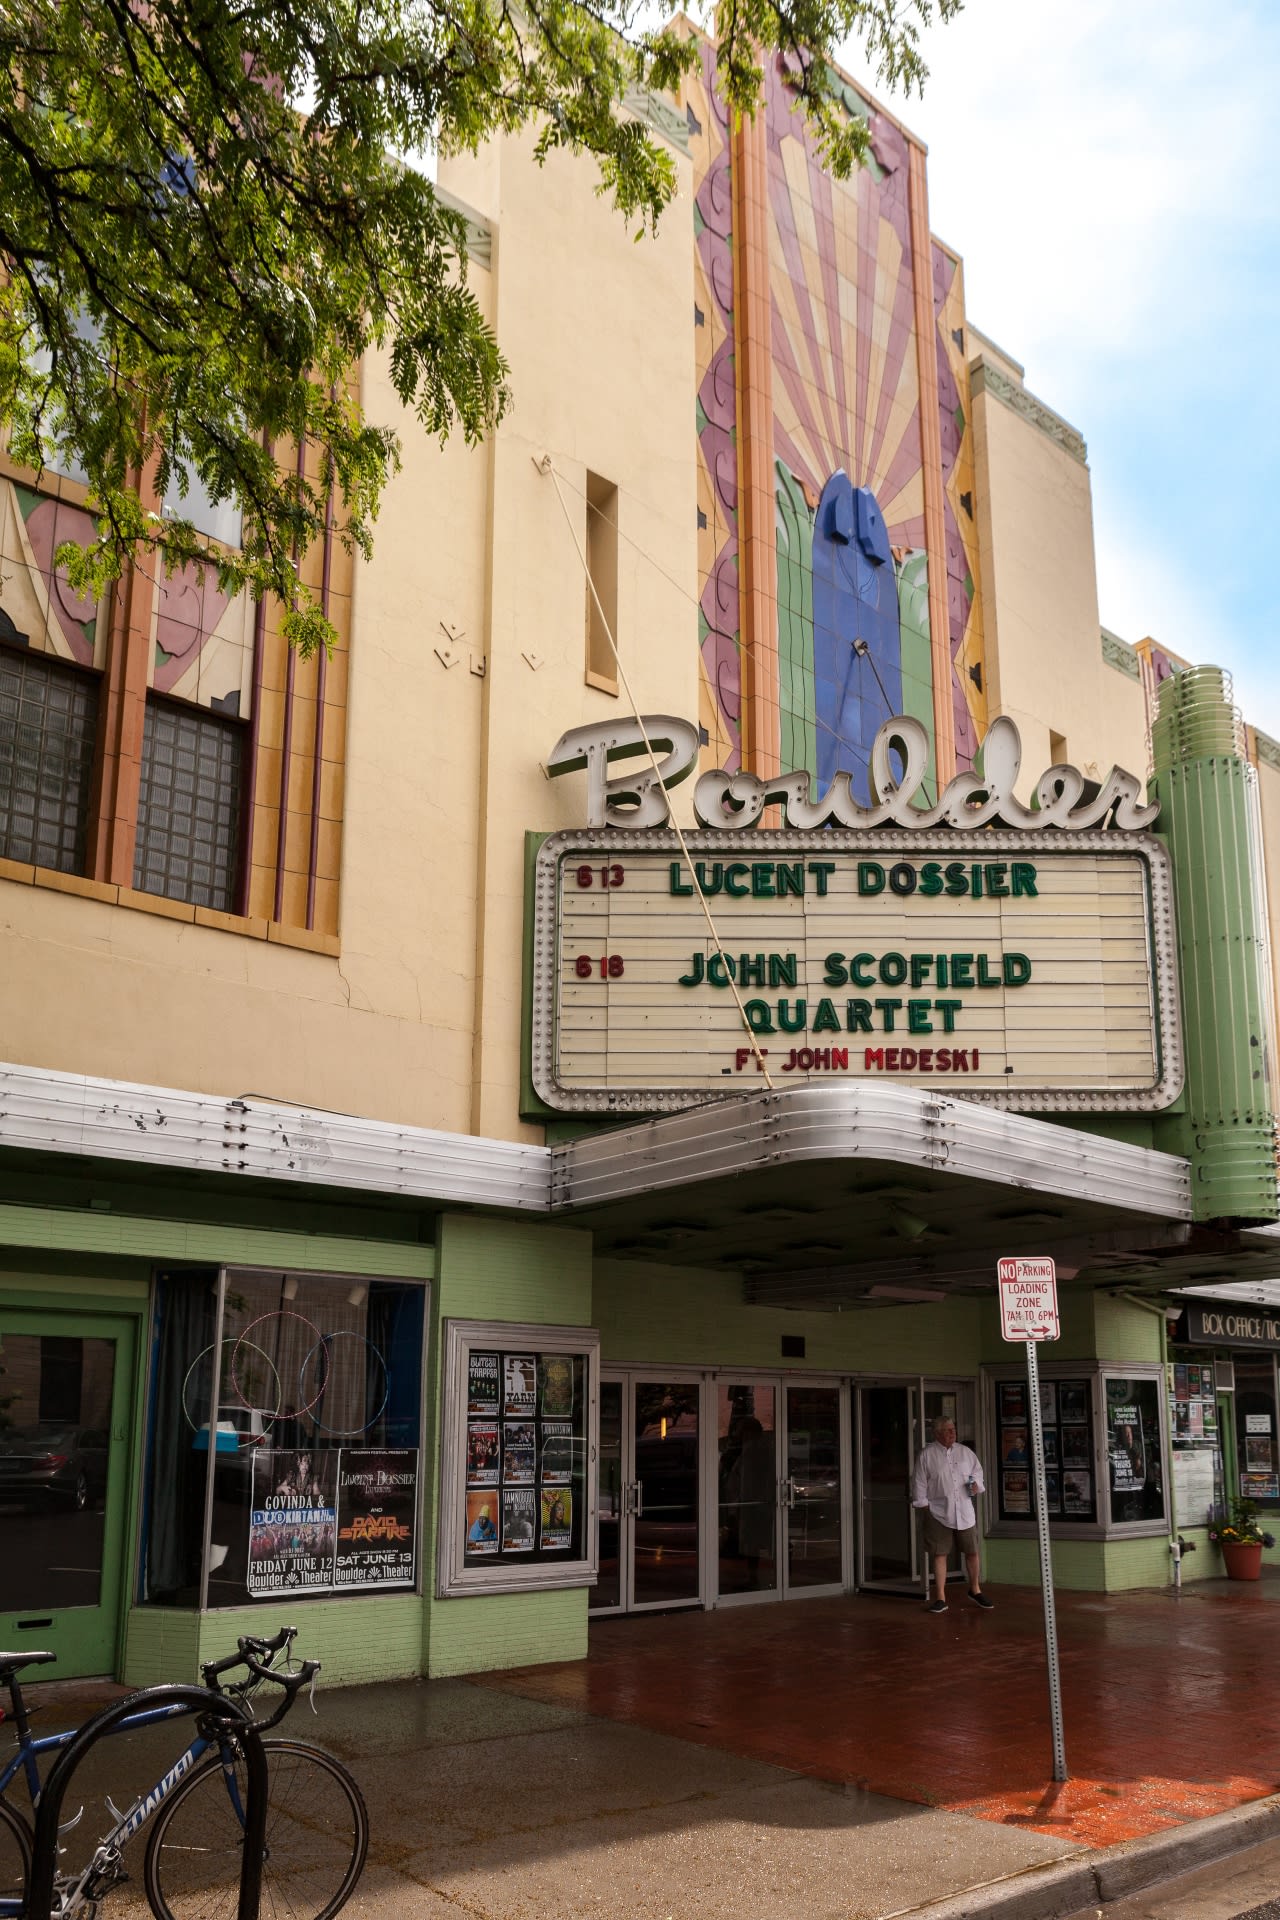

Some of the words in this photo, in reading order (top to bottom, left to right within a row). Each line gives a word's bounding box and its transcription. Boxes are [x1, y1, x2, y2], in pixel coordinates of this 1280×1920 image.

[547, 714, 1161, 829] Boulder
[577, 864, 593, 888] 6
[601, 864, 625, 888] 13
[670, 862, 836, 896] LUCENT
[857, 861, 1039, 897] DOSSIER
[575, 954, 593, 978] 6
[600, 954, 625, 978] 18
[679, 952, 798, 987] JOHN
[823, 951, 1032, 988] SCOFIELD
[743, 998, 963, 1033] QUARTET
[735, 1048, 769, 1071] FT
[781, 1047, 849, 1071] JOHN
[864, 1047, 980, 1072] MEDESKI
[1000, 1263, 1016, 1280] NO
[1017, 1265, 1051, 1277] PARKING
[1008, 1283, 1048, 1294] LOADING
[1016, 1297, 1042, 1308] ZONE
[1006, 1310, 1022, 1321] 7AM
[1024, 1310, 1035, 1321] TO
[1038, 1310, 1054, 1321] 6PM
[1202, 1312, 1225, 1336] BOX
[506, 1392, 536, 1402] YARN
[341, 1471, 374, 1486] LUCENT
[377, 1470, 416, 1486] DOSSIER
[265, 1495, 313, 1510] GOVINDA
[317, 1495, 325, 1508] &
[285, 1510, 321, 1524] KIRTAN
[352, 1515, 397, 1528] DAVID
[338, 1526, 411, 1541] STARFIRE
[250, 1560, 288, 1574] FRIDAY
[291, 1557, 317, 1571] JUNE
[321, 1557, 332, 1569] 12
[336, 1555, 360, 1567] SAT
[363, 1554, 396, 1564] JUNE
[399, 1552, 412, 1563] 13
[249, 1573, 284, 1588] Boulder
[300, 1569, 332, 1584] Theater
[335, 1567, 367, 1581] Boulder
[382, 1564, 413, 1578] Theater
